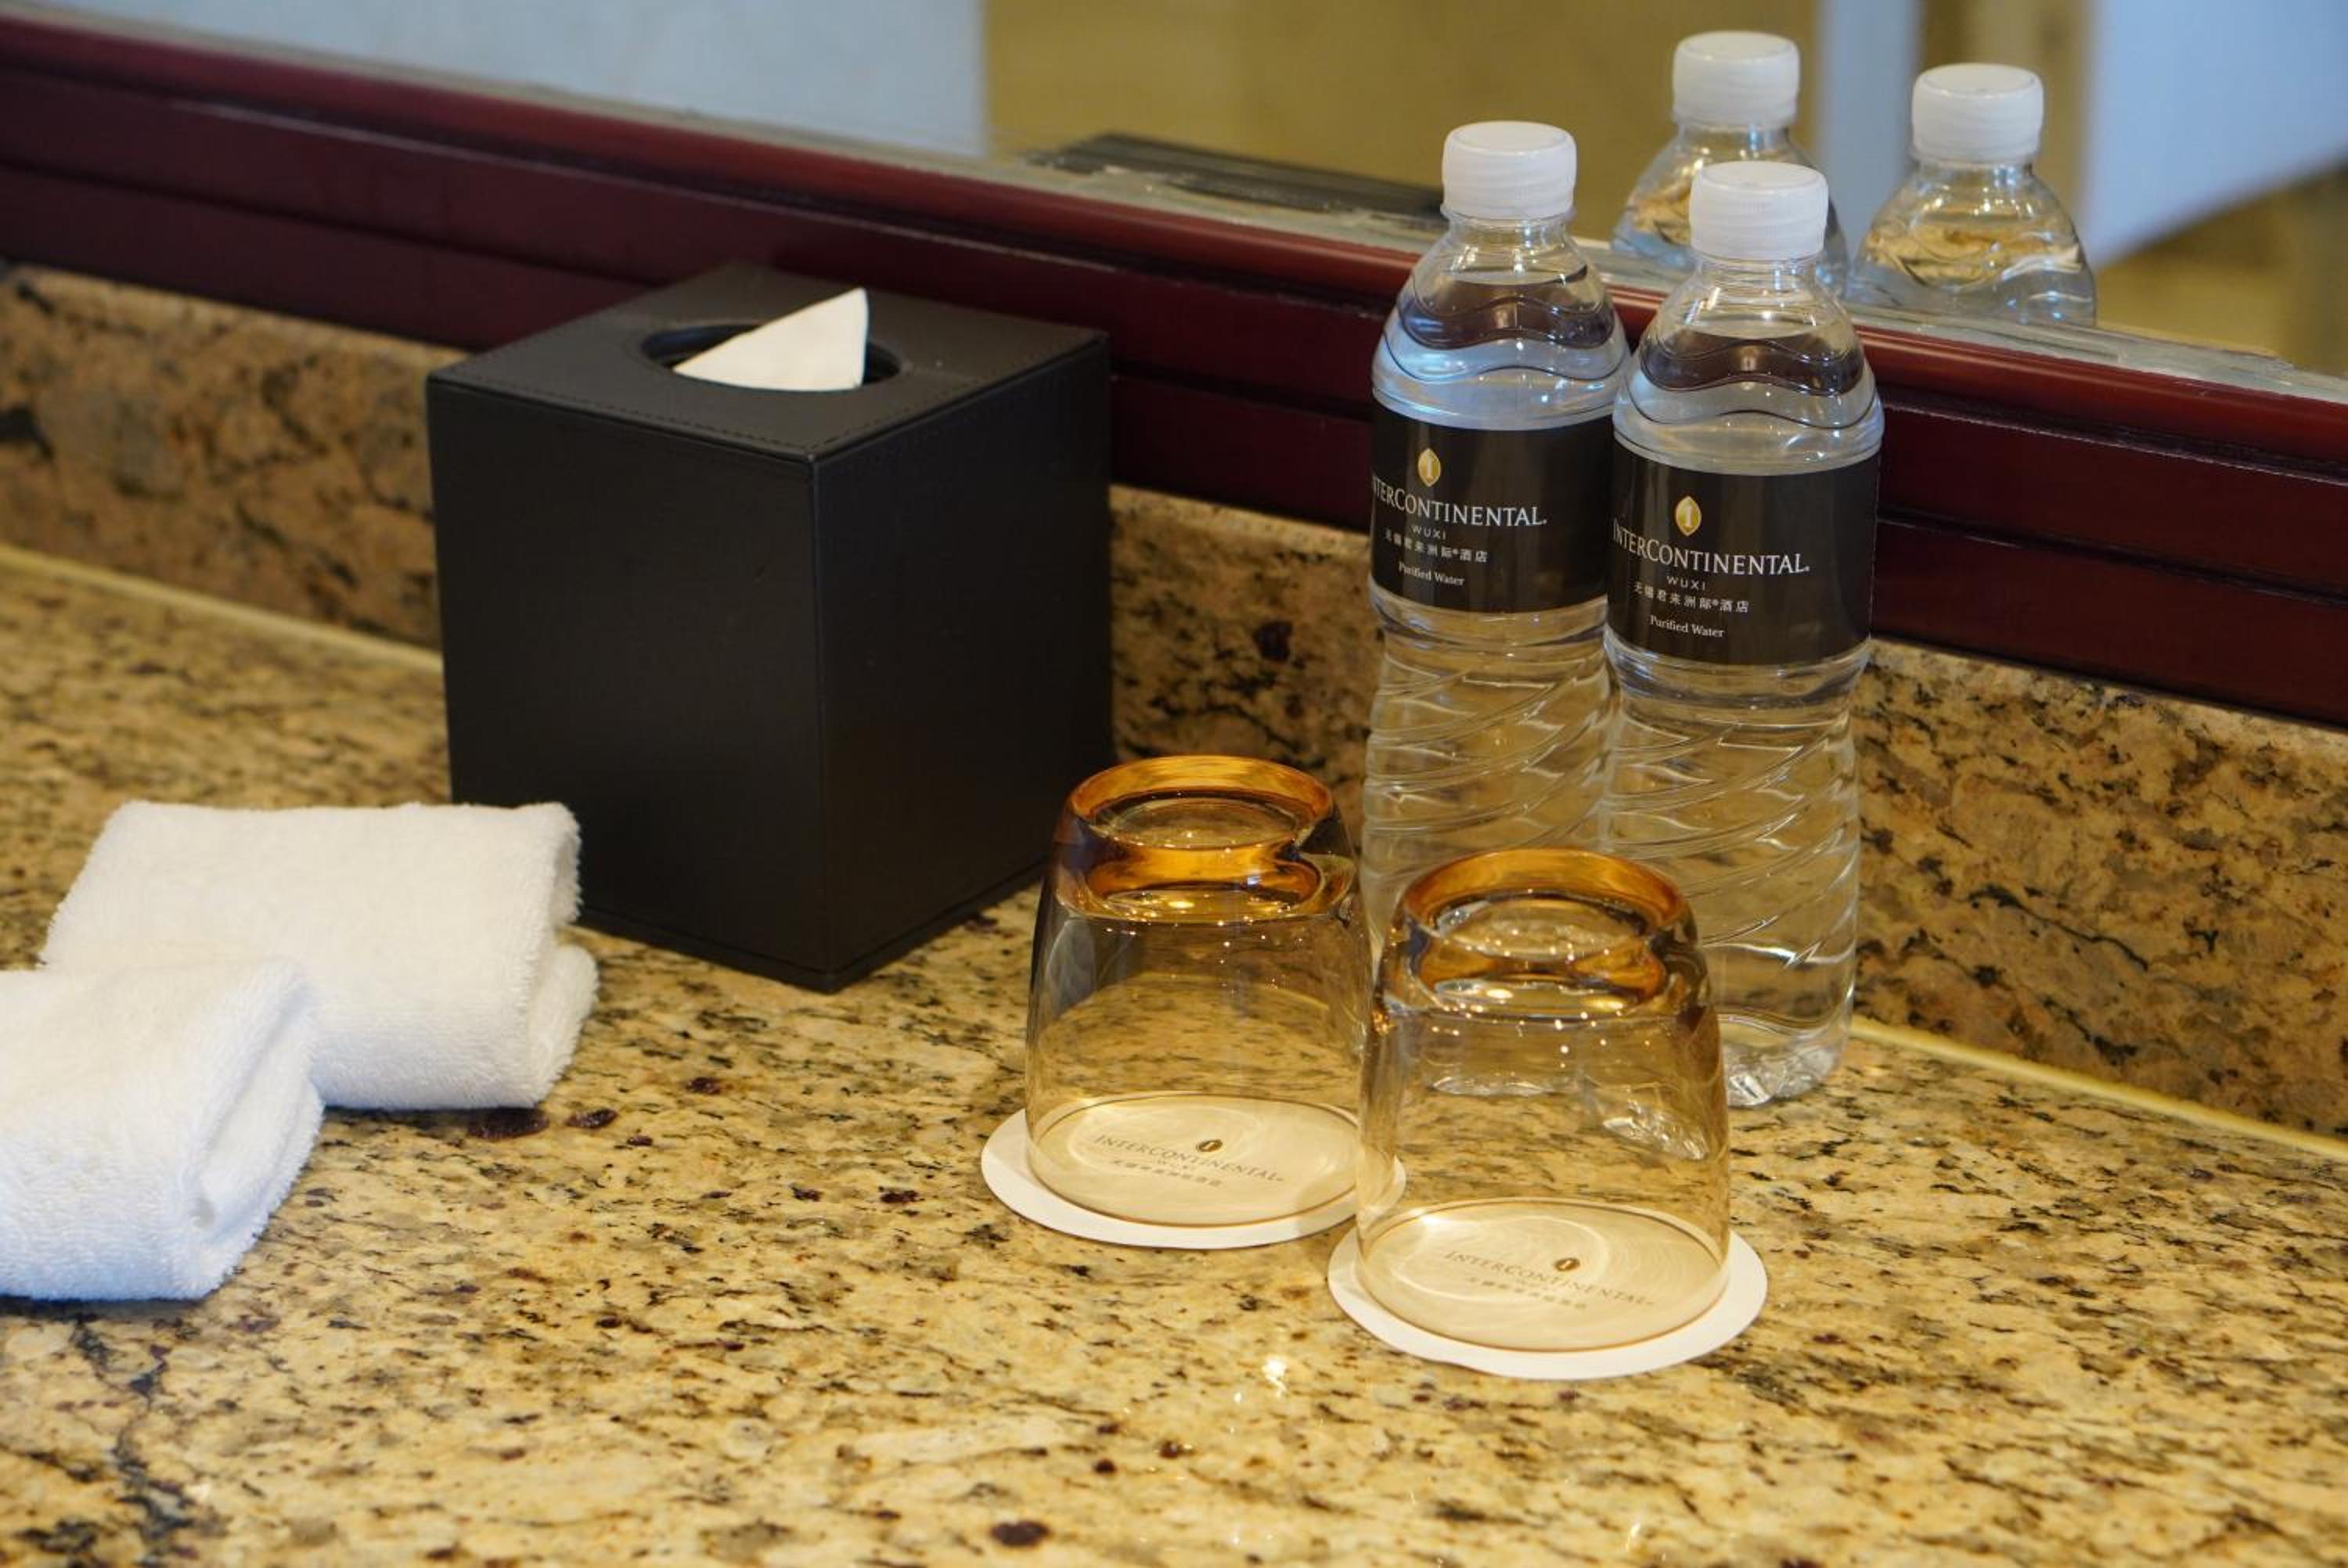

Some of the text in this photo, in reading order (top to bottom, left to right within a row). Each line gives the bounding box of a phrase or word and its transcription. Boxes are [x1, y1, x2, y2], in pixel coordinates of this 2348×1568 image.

[1373, 475, 1545, 527] TERCONTINENTAL
[1411, 525, 1446, 540] WUXI
[1614, 517, 1807, 576] INTERCONTINENTAL
[1666, 575, 1706, 591] WUXI
[1649, 614, 1725, 638] Purified Water
